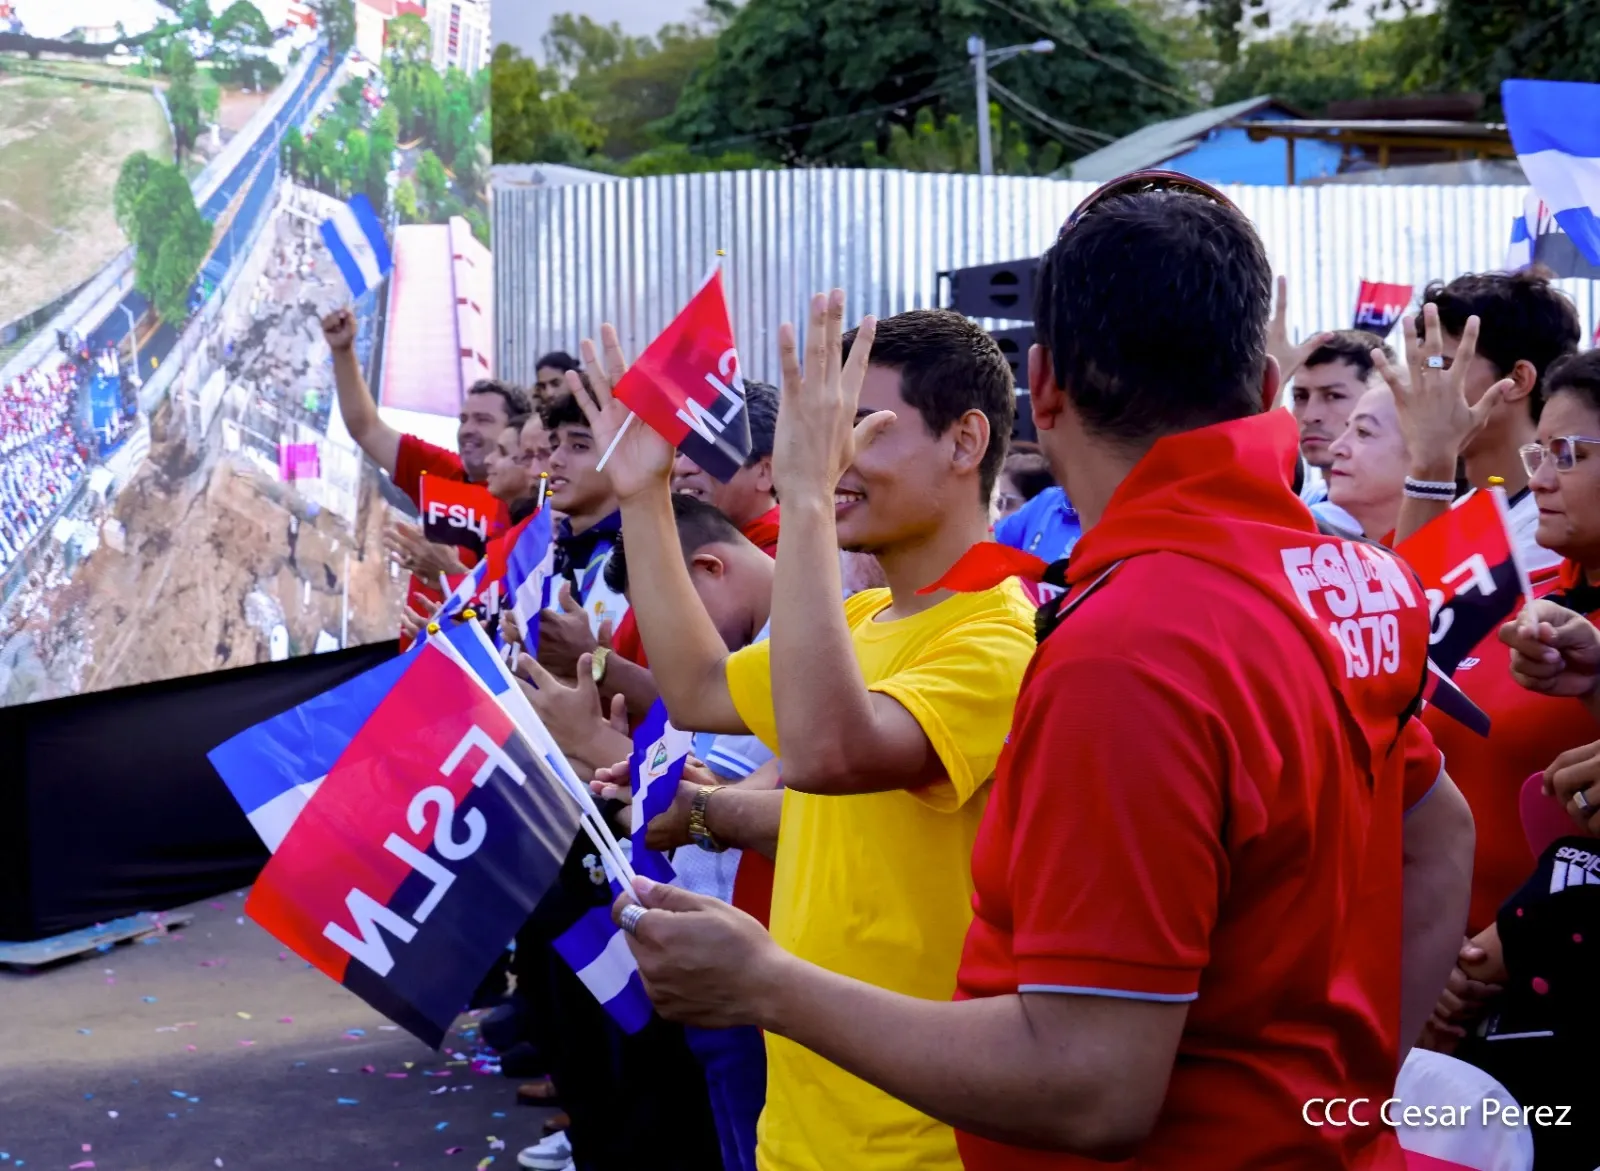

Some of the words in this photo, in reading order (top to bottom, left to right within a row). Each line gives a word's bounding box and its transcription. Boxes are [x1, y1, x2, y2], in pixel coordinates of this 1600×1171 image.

[1280, 541, 1418, 620] FSLN
[1328, 613, 1400, 679] 1979
[1555, 846, 1600, 873] didas
